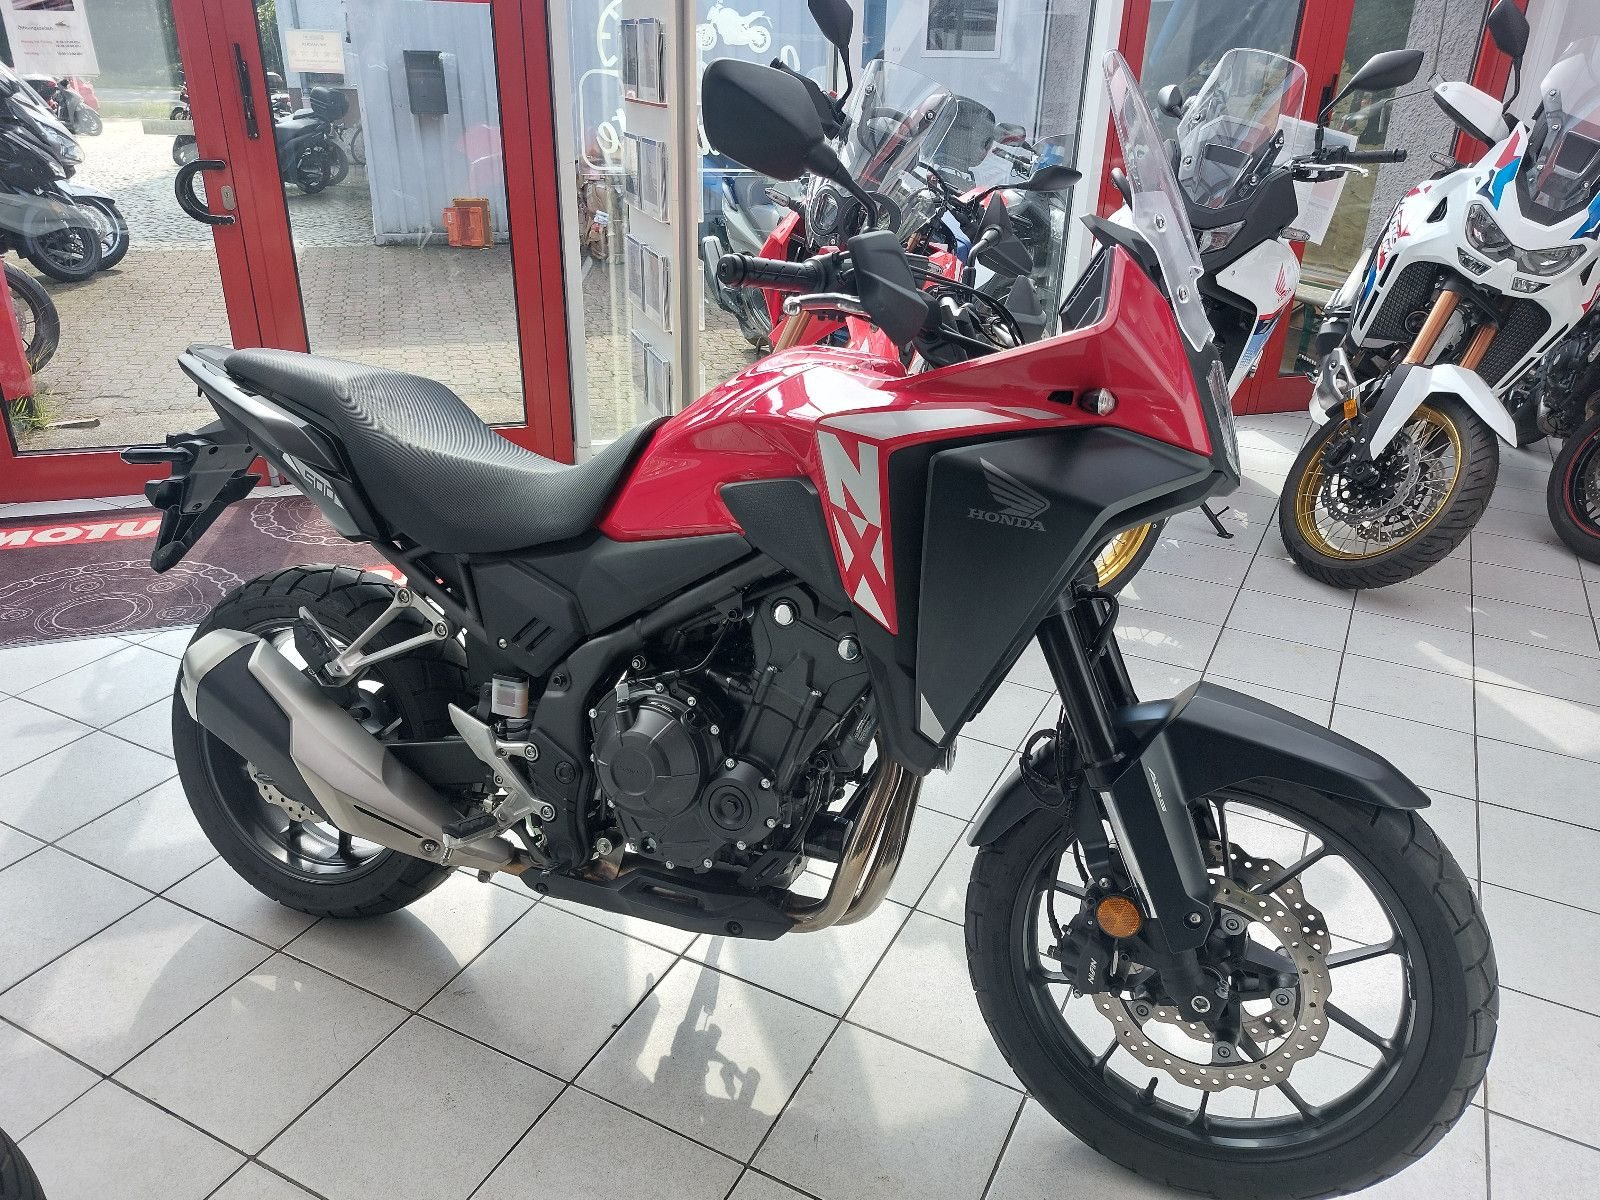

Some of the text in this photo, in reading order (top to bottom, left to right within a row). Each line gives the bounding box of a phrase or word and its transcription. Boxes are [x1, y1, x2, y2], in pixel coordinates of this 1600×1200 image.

[304, 470, 335, 502] 500
[0, 519, 162, 547] MOTU
[816, 430, 891, 629] NX
[967, 507, 1047, 532] HONDA
